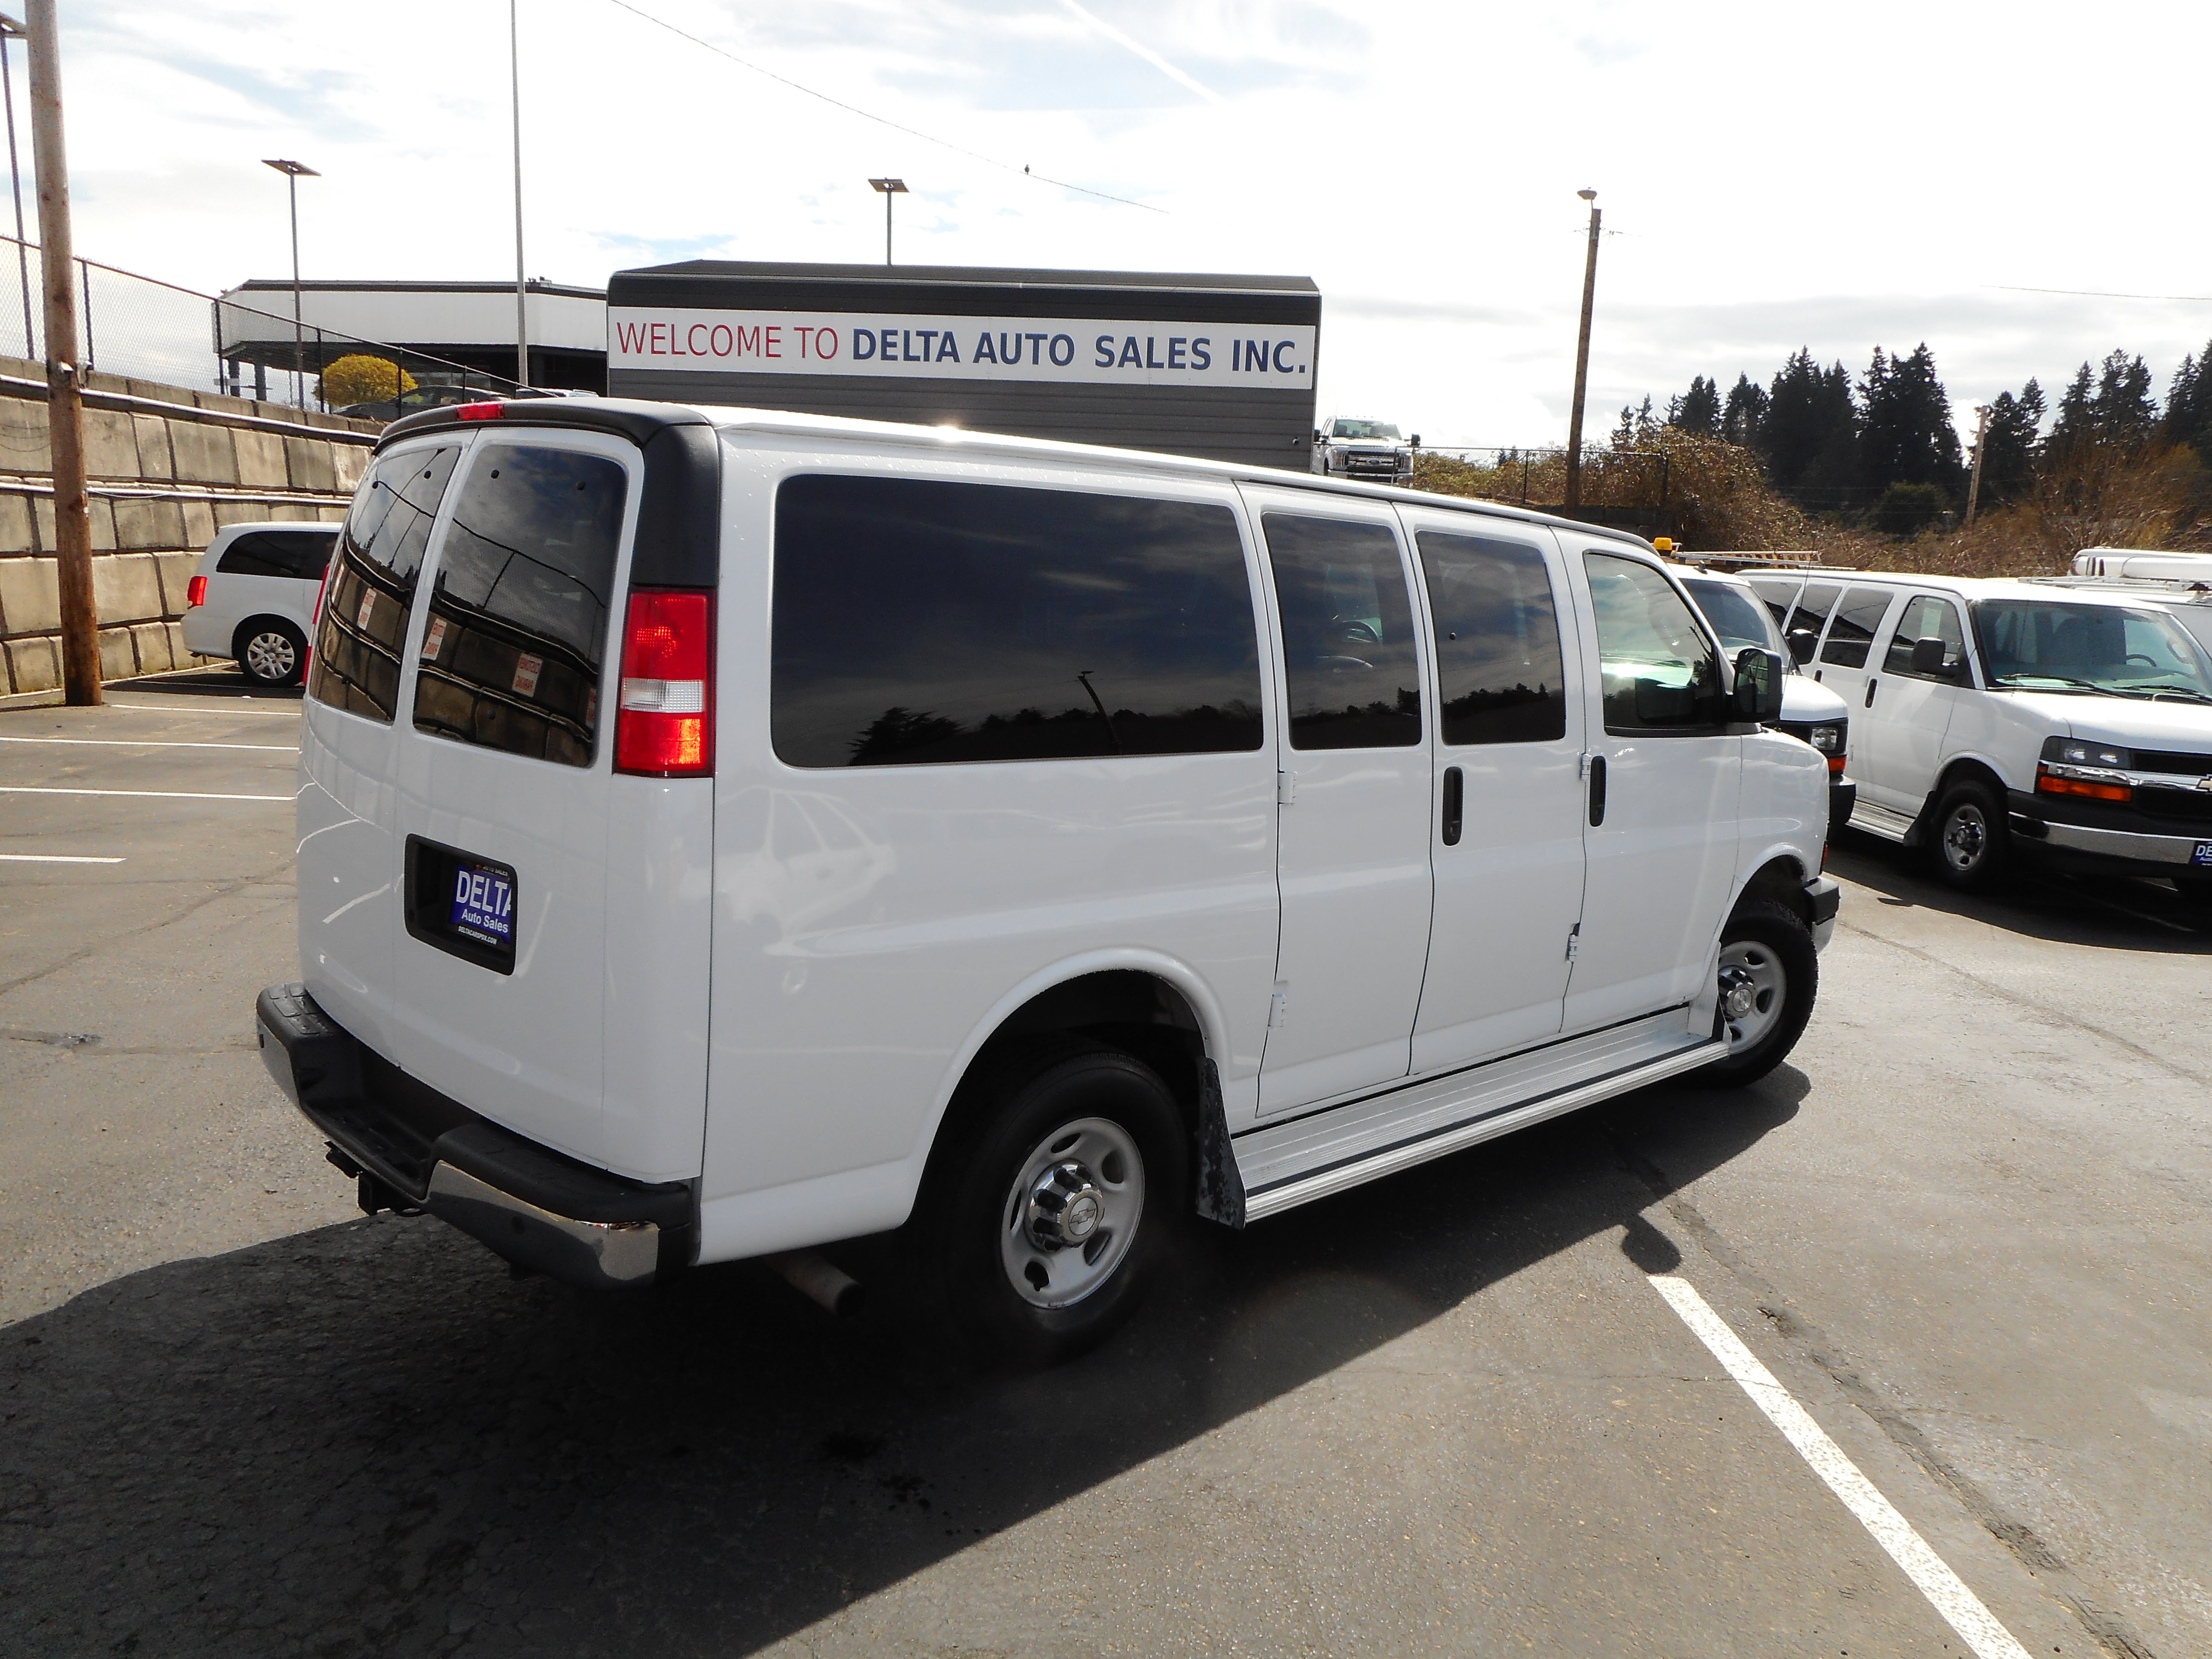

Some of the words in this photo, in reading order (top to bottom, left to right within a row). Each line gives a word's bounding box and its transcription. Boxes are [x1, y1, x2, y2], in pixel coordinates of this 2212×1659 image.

[616, 322, 781, 358] WELCOME
[793, 326, 839, 360] TO
[852, 328, 961, 363] DELTA
[972, 331, 1075, 366] AUTO
[1095, 334, 1211, 370] SALES
[1232, 339, 1306, 374] INC.
[461, 908, 481, 925] Auto
[483, 915, 508, 933] Sales
